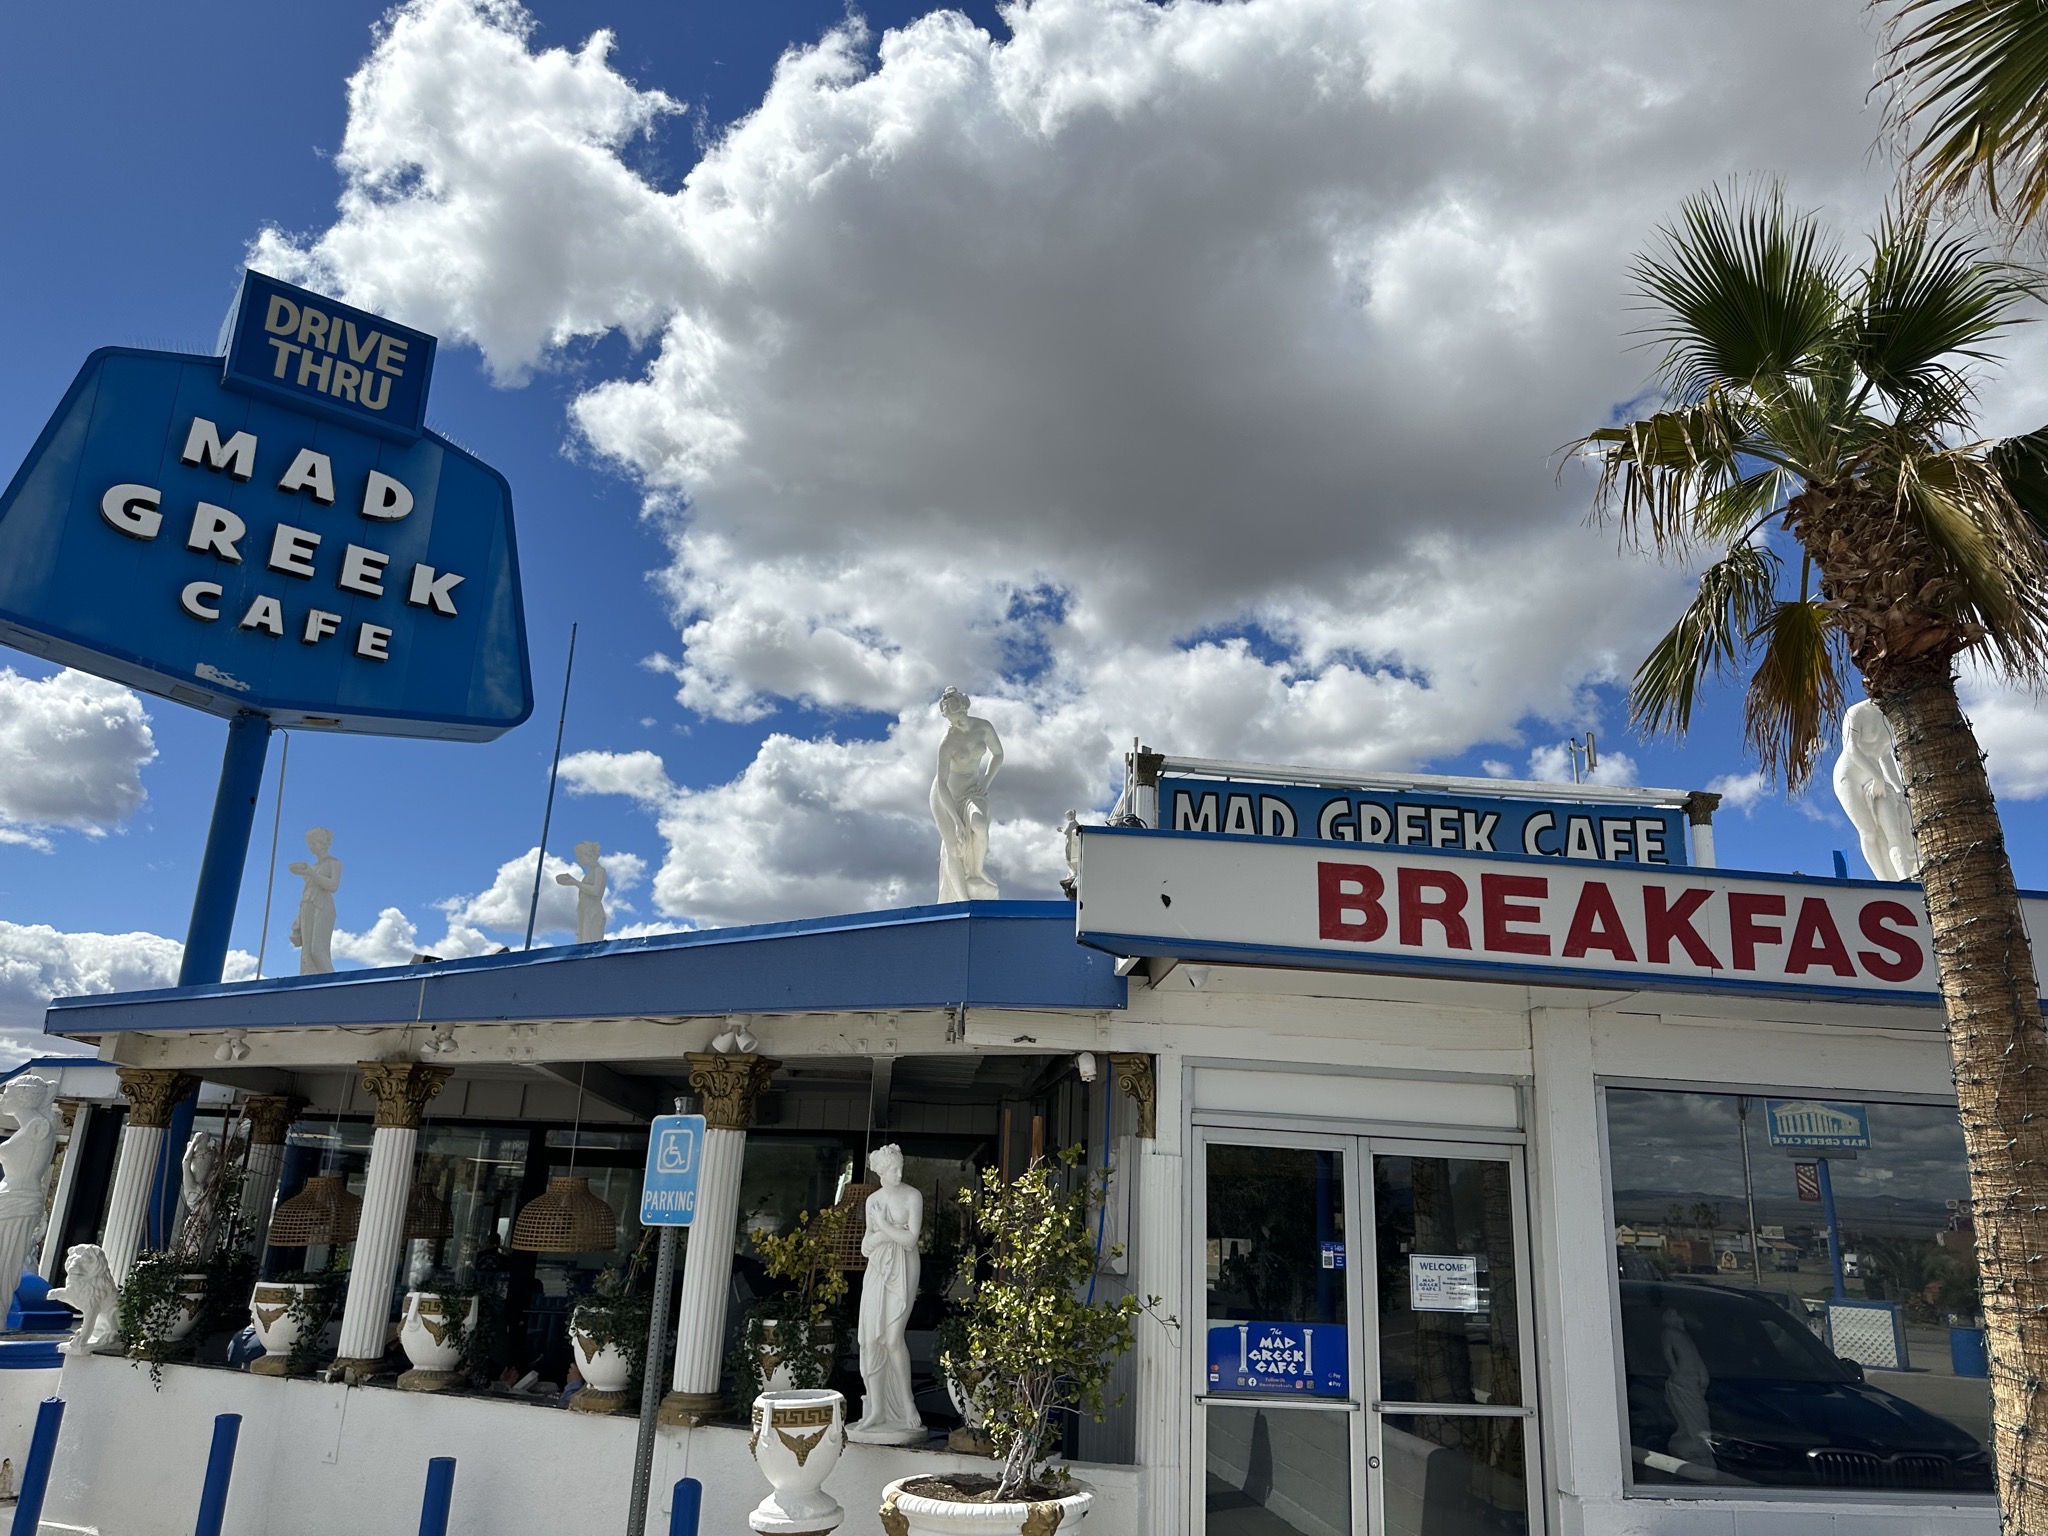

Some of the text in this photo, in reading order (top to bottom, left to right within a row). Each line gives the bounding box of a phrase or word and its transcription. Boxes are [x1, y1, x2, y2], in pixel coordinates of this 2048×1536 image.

[265, 294, 409, 377] DRIVE
[268, 337, 392, 411] THRU
[181, 416, 415, 523] MAD
[102, 483, 466, 618] GREEK
[180, 581, 393, 663] CAFE
[1174, 790, 1669, 865] MAD GREEK CAFE
[1317, 861, 1932, 983] BREAKFAS
[644, 1190, 695, 1212] PARKING
[1419, 1262, 1467, 1272] WELCOME!
[1248, 1349, 1305, 1362] GREEK
[1255, 1361, 1298, 1375] CAFE
[1259, 1336, 1297, 1349] MAD
[1269, 1327, 1282, 1336] The
